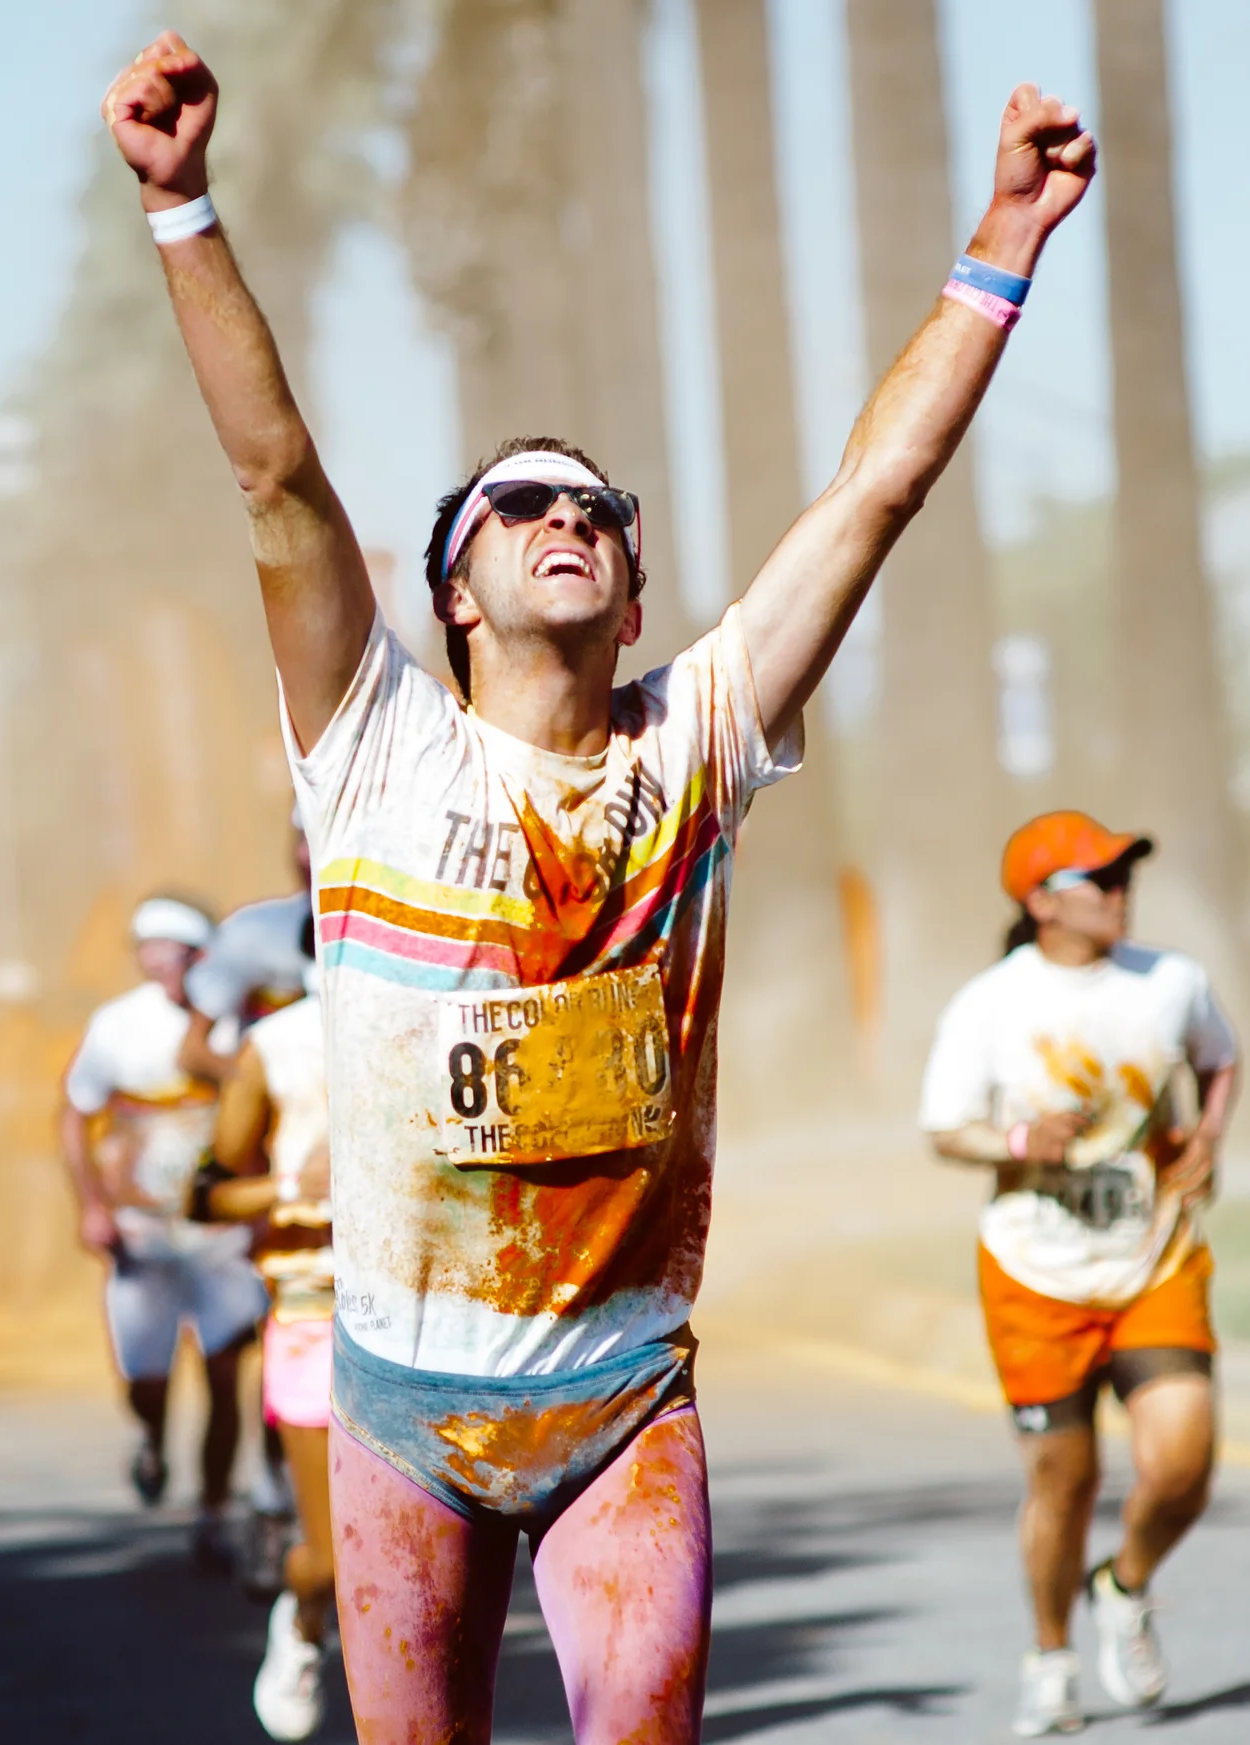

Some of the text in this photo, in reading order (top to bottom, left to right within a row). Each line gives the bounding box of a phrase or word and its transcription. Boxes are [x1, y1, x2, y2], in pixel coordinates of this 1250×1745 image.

[434, 810, 519, 891] THE
[458, 1000, 502, 1034] THE
[449, 1016, 667, 1119] 860
[464, 1124, 510, 1154] THE
